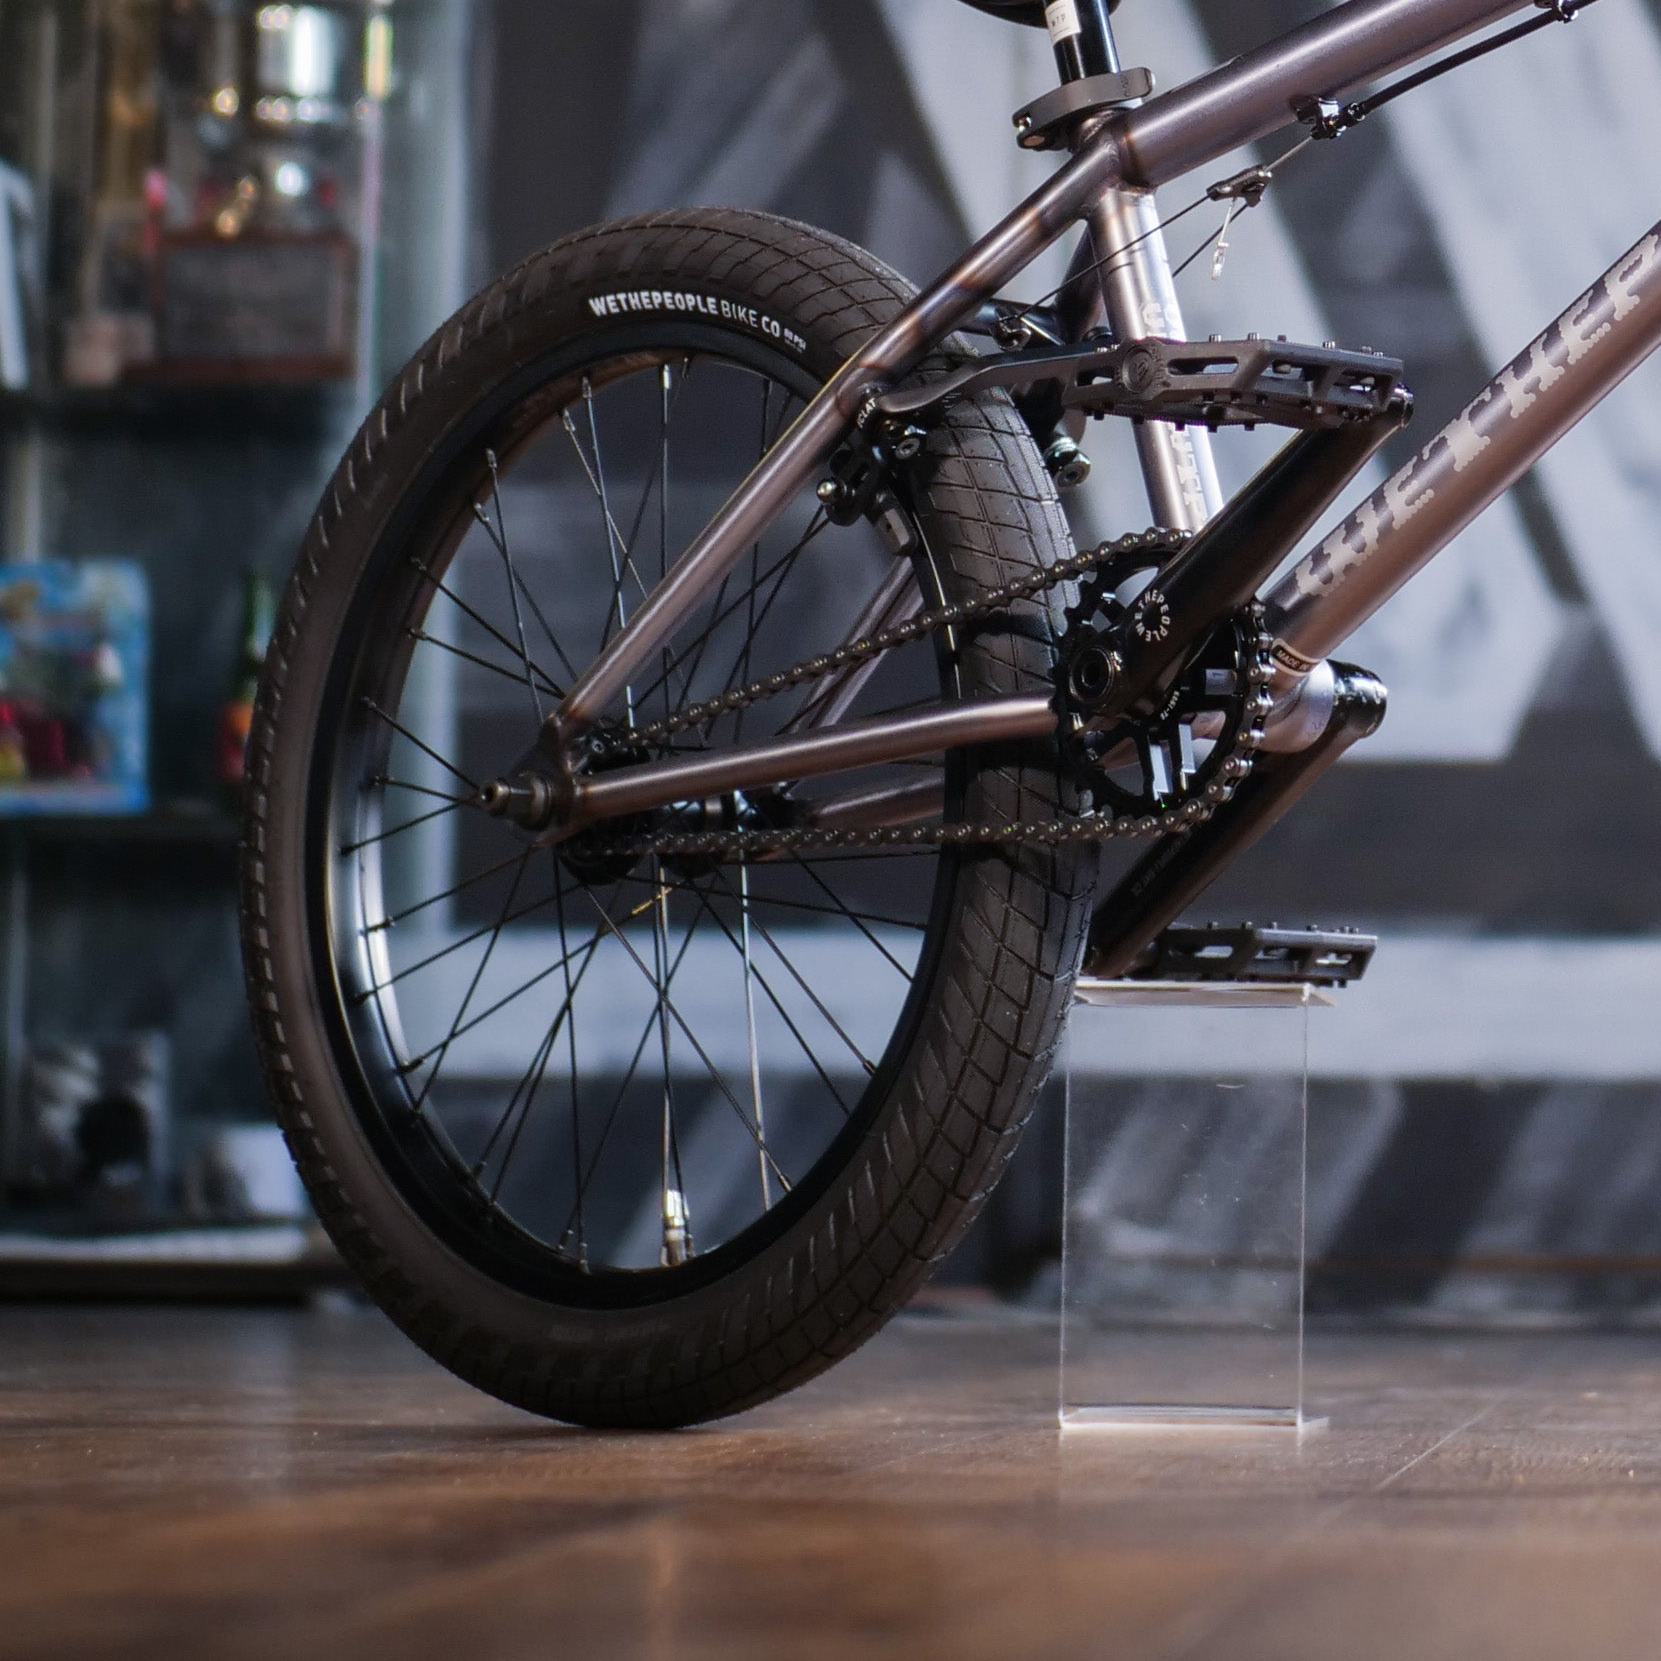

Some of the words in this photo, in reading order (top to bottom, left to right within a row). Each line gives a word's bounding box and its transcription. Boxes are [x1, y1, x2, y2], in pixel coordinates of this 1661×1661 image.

[588, 290, 719, 318] WETHEPEOPLE
[720, 299, 759, 328] BIKE
[760, 315, 781, 338] CO
[1134, 589, 1171, 642] WETHEPEOPLE
[1275, 648, 1299, 667] MADE
